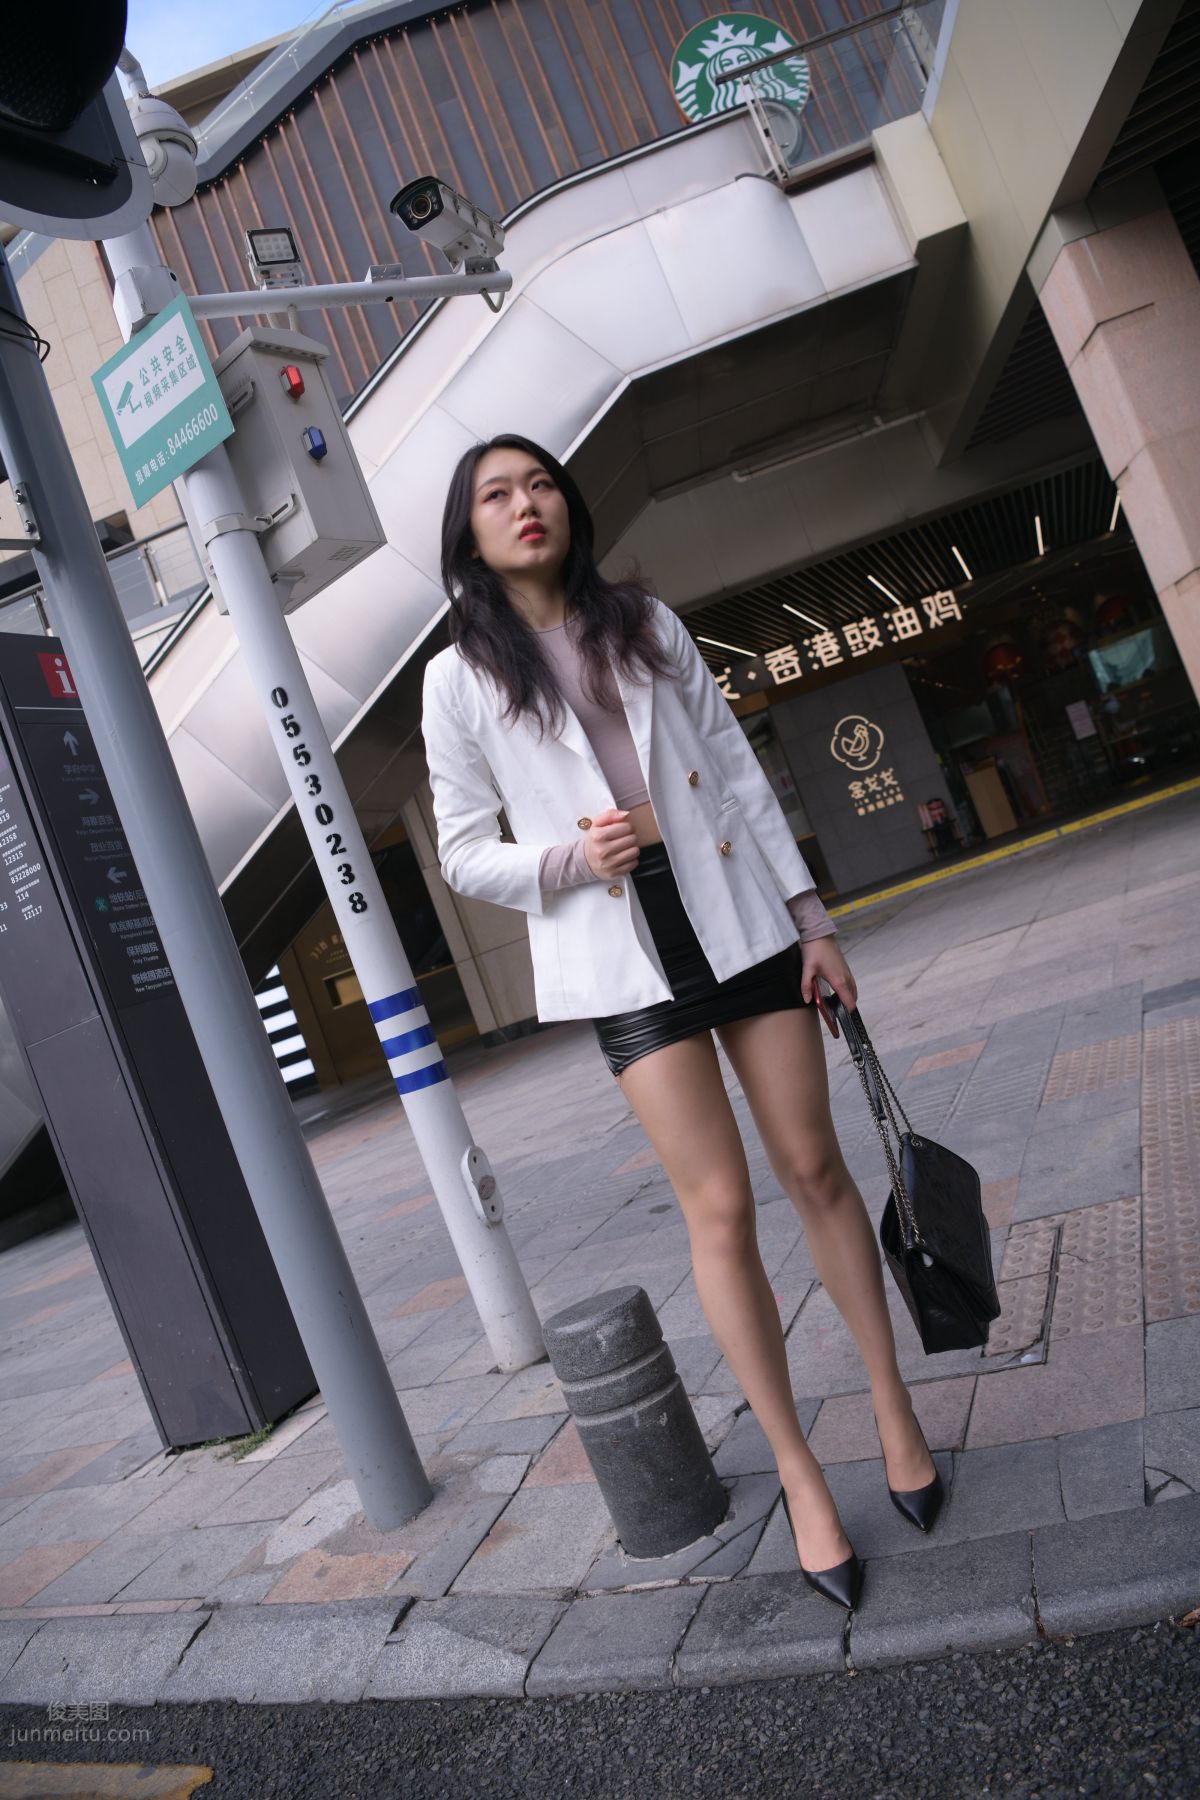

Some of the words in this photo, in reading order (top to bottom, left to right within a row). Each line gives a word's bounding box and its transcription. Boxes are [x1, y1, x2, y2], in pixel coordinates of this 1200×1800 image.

[139, 335, 187, 386] 公共安全
[143, 354, 197, 408] 视频采集区域
[271, 686, 367, 914] 05530238
[4, 850, 24, 866] 12315
[10, 863, 41, 884] 83228000
[17, 891, 29, 902] 114
[23, 905, 43, 920] 12117
